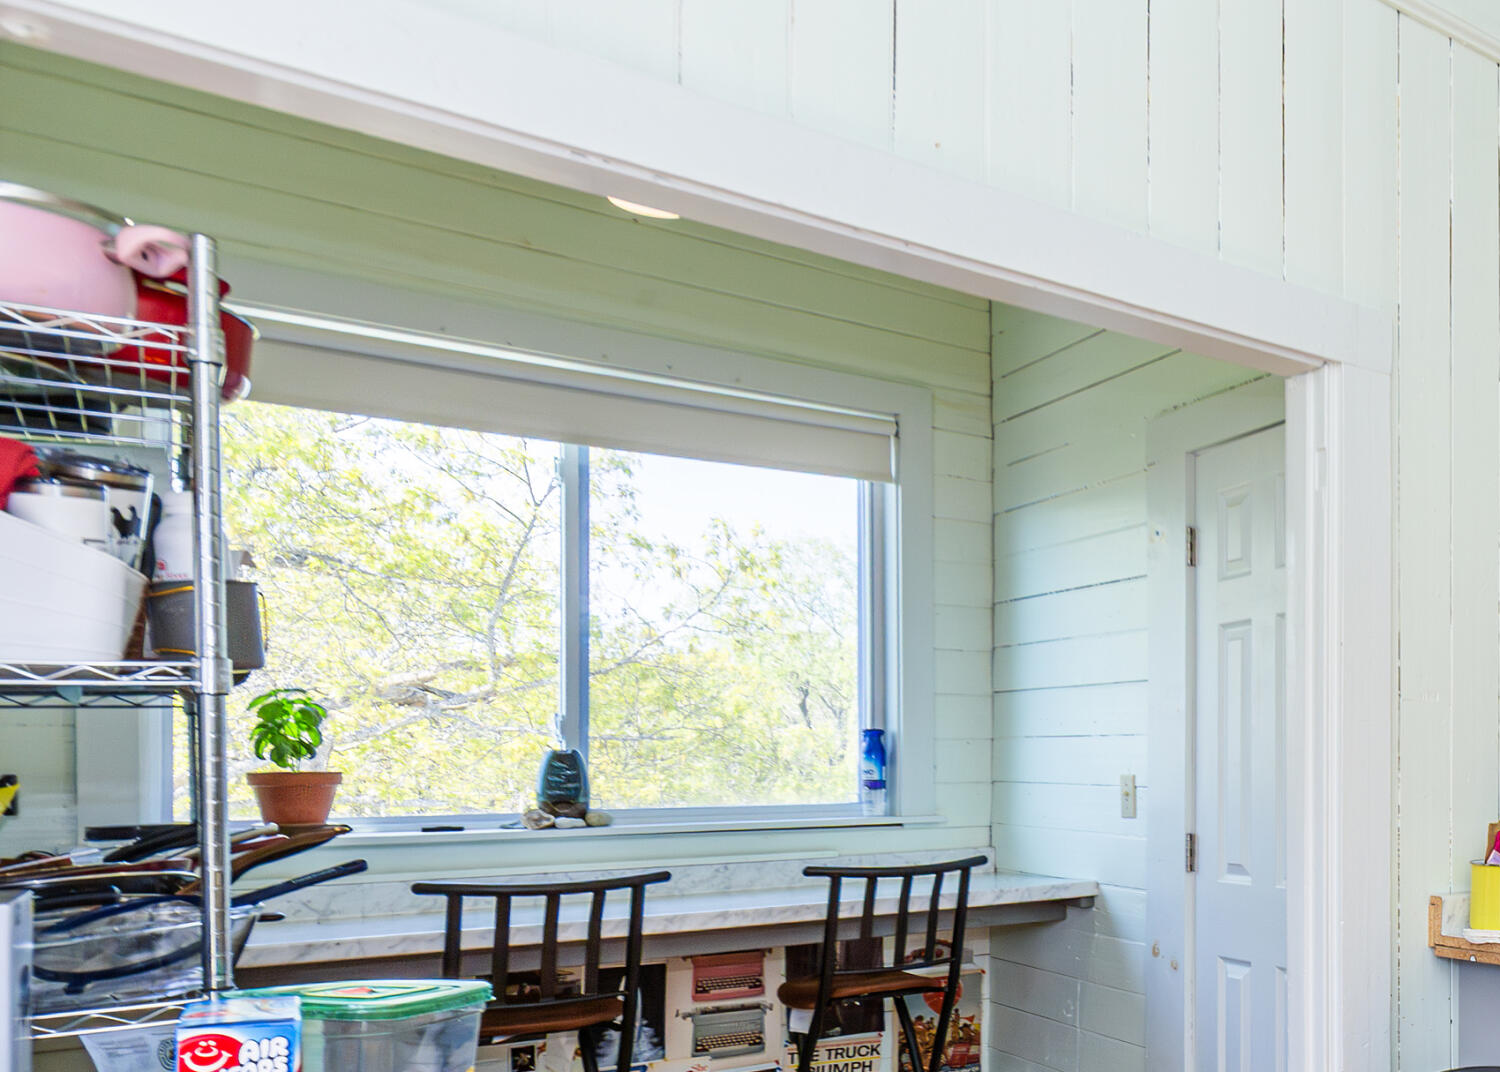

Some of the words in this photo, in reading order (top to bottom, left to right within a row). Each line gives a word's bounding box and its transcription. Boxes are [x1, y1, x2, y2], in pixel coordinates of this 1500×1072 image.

[238, 1036, 289, 1064] AIR
[787, 1050, 819, 1064] TE
[825, 1043, 881, 1060] TRUCK
